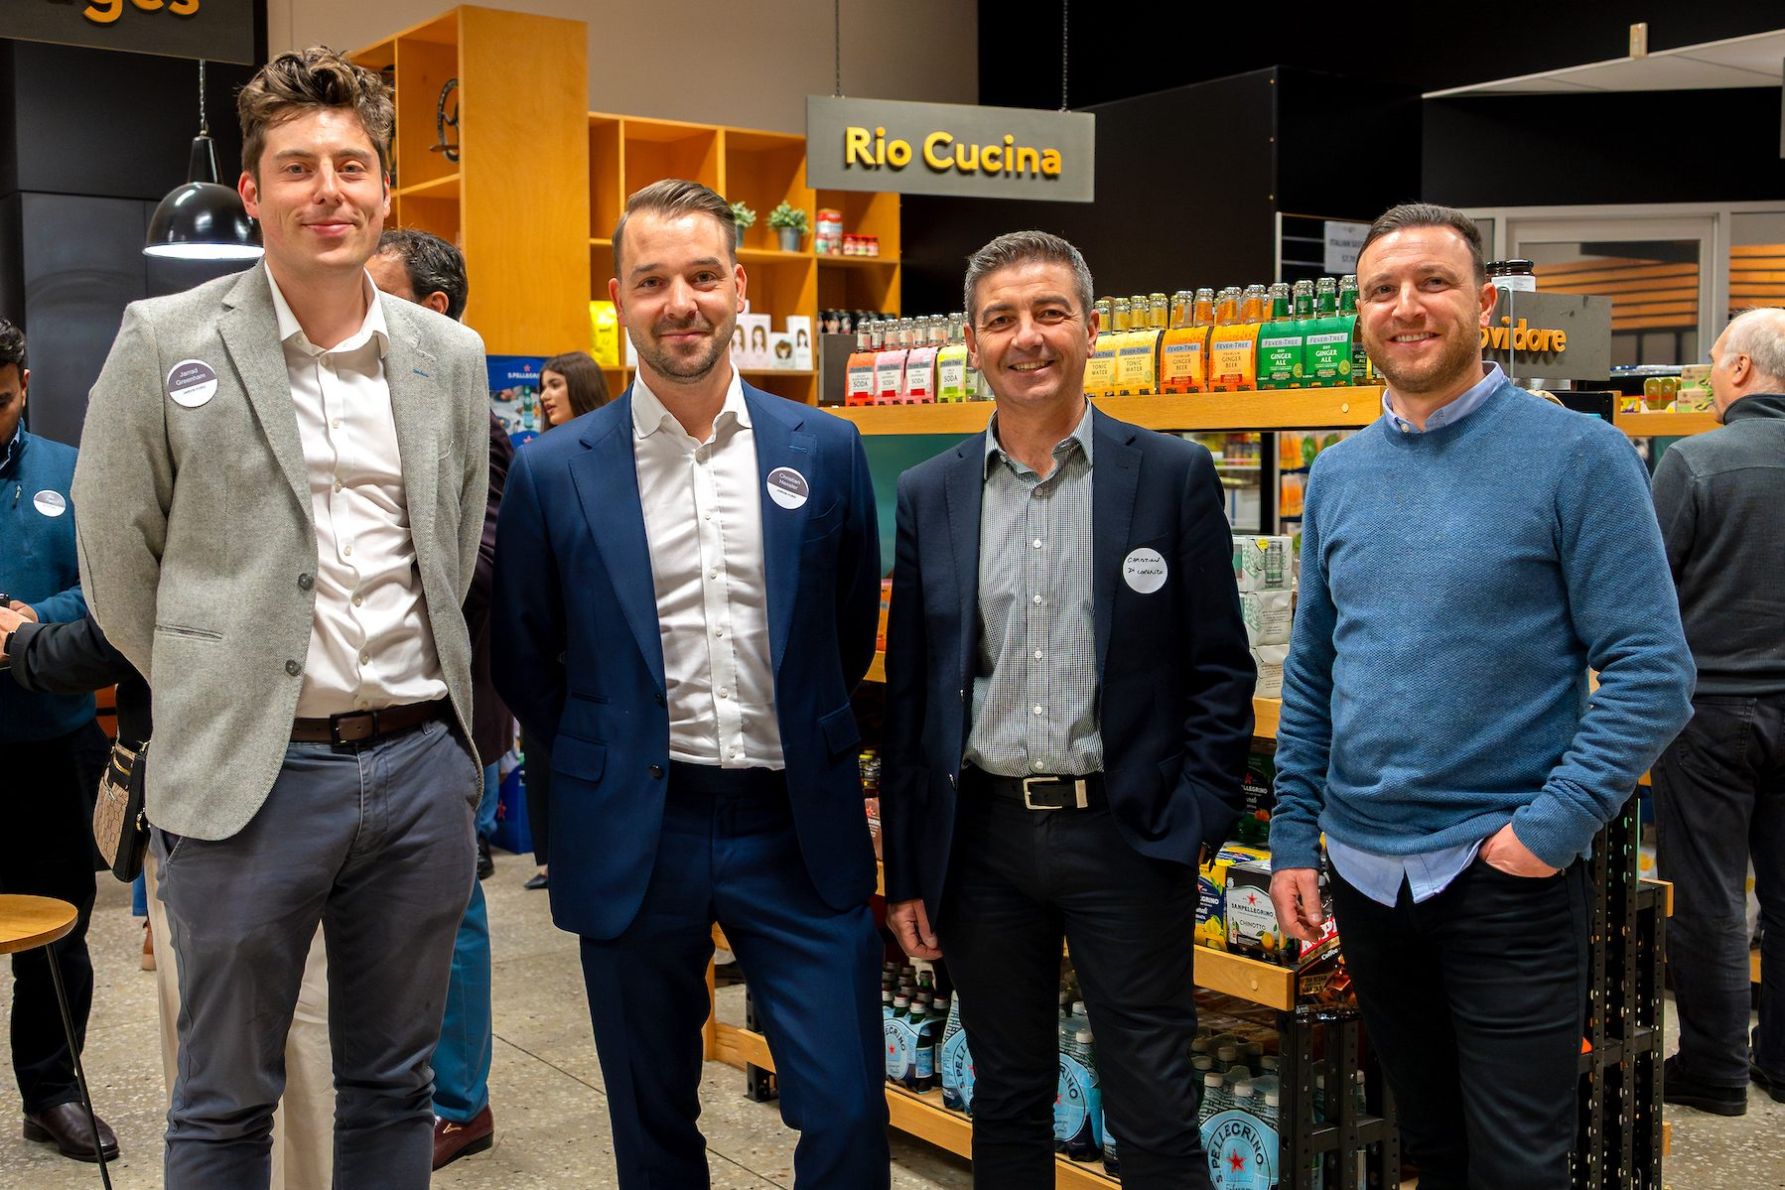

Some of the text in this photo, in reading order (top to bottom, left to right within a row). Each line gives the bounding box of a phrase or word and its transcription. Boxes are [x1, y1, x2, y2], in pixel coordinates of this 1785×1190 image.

[846, 126, 1062, 175] Rio Cucina
[1315, 349, 1337, 357] GINGER
[1241, 784, 1268, 794] LLEGRINO
[1200, 896, 1219, 905] GRINO
[1231, 903, 1273, 918] SANPELLEGRINO
[1239, 919, 1266, 931] CHINOTTO
